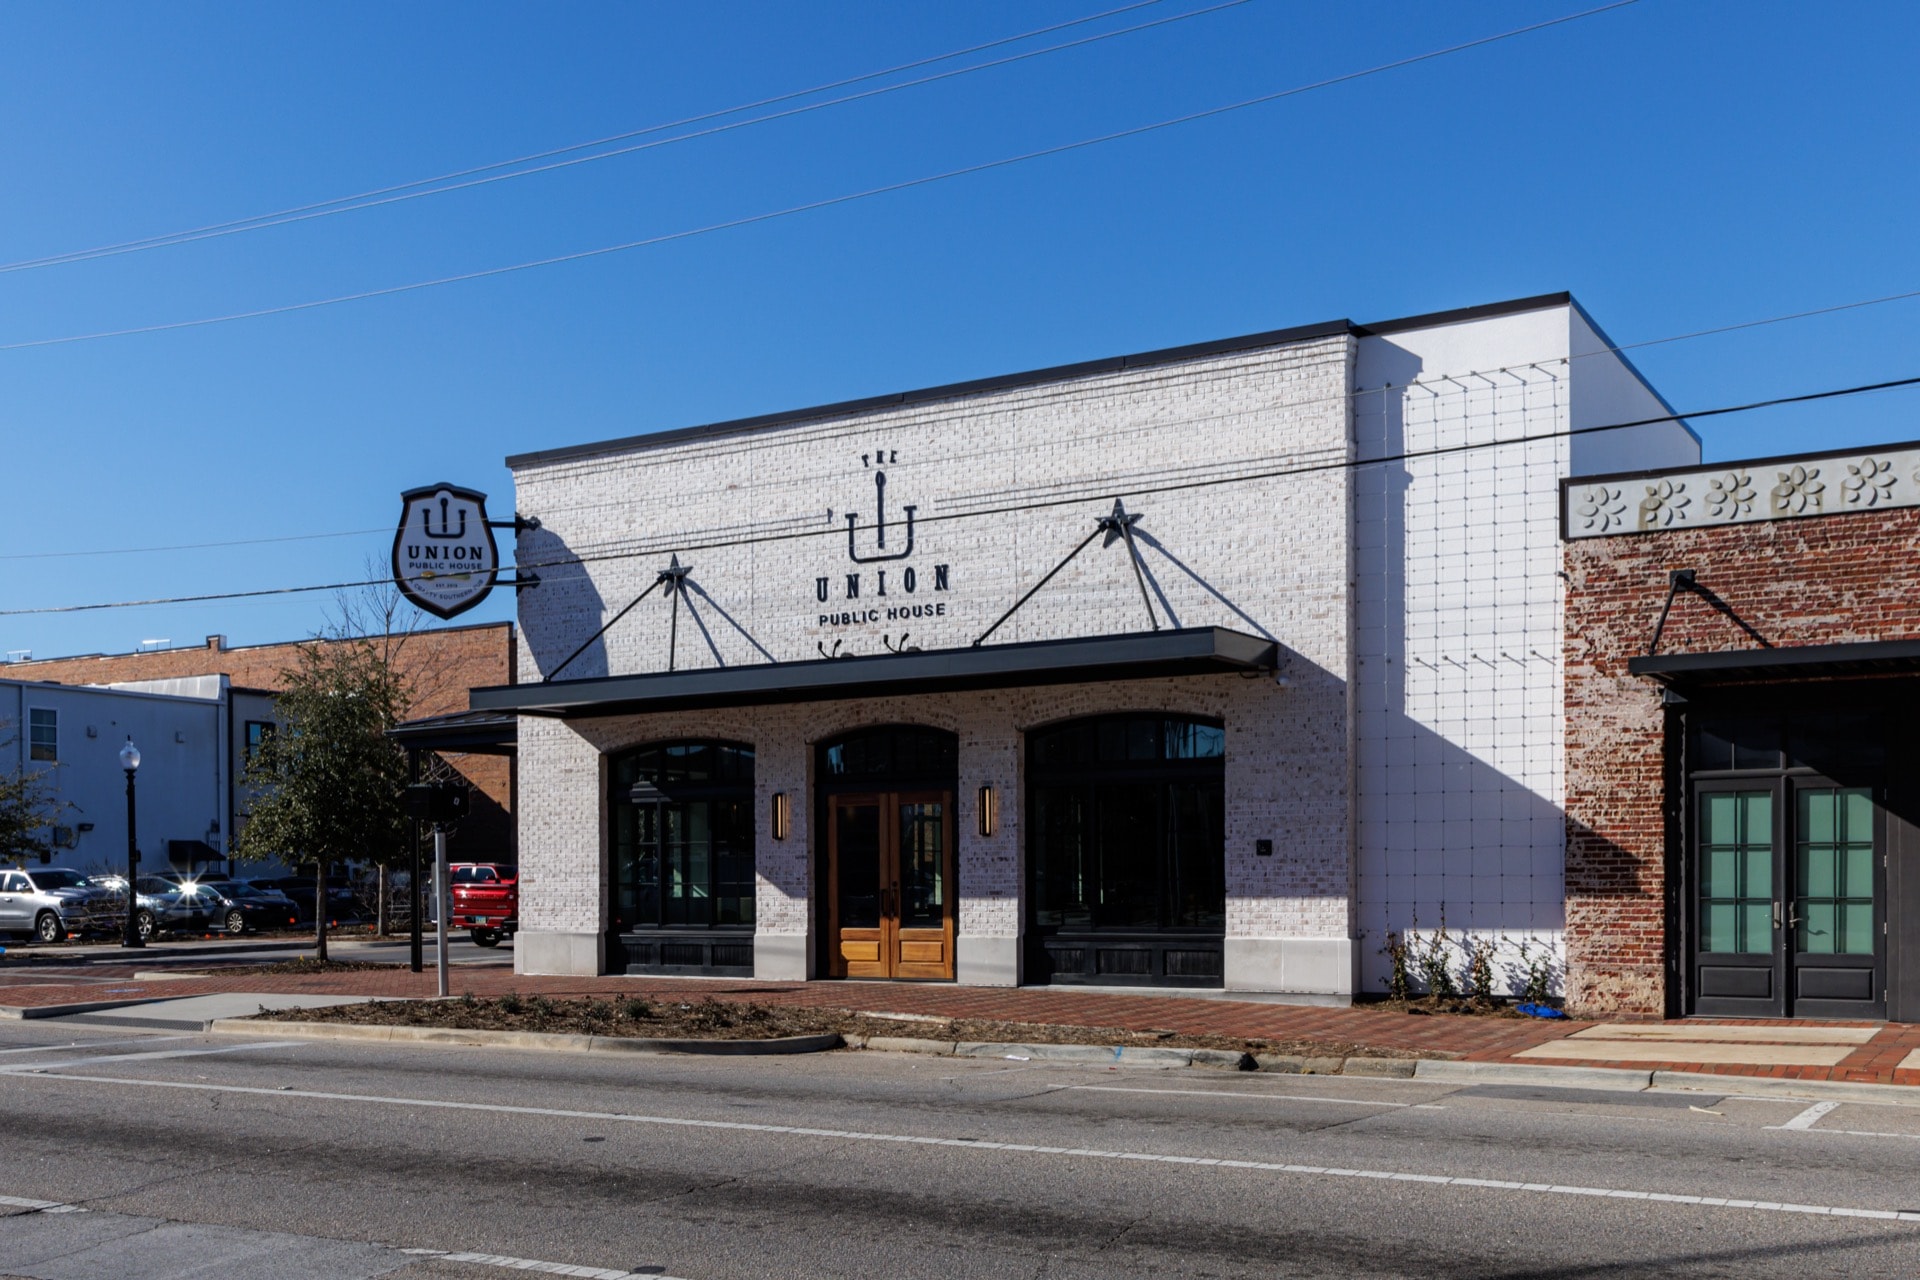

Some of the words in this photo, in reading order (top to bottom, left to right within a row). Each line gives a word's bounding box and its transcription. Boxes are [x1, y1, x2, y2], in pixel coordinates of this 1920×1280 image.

[861, 450, 898, 468] THE
[407, 545, 483, 560] UNION
[449, 562, 483, 570] HOUSE
[816, 564, 949, 602] UNION
[819, 609, 879, 627] PUBLIC
[887, 603, 946, 619] HOUSE
